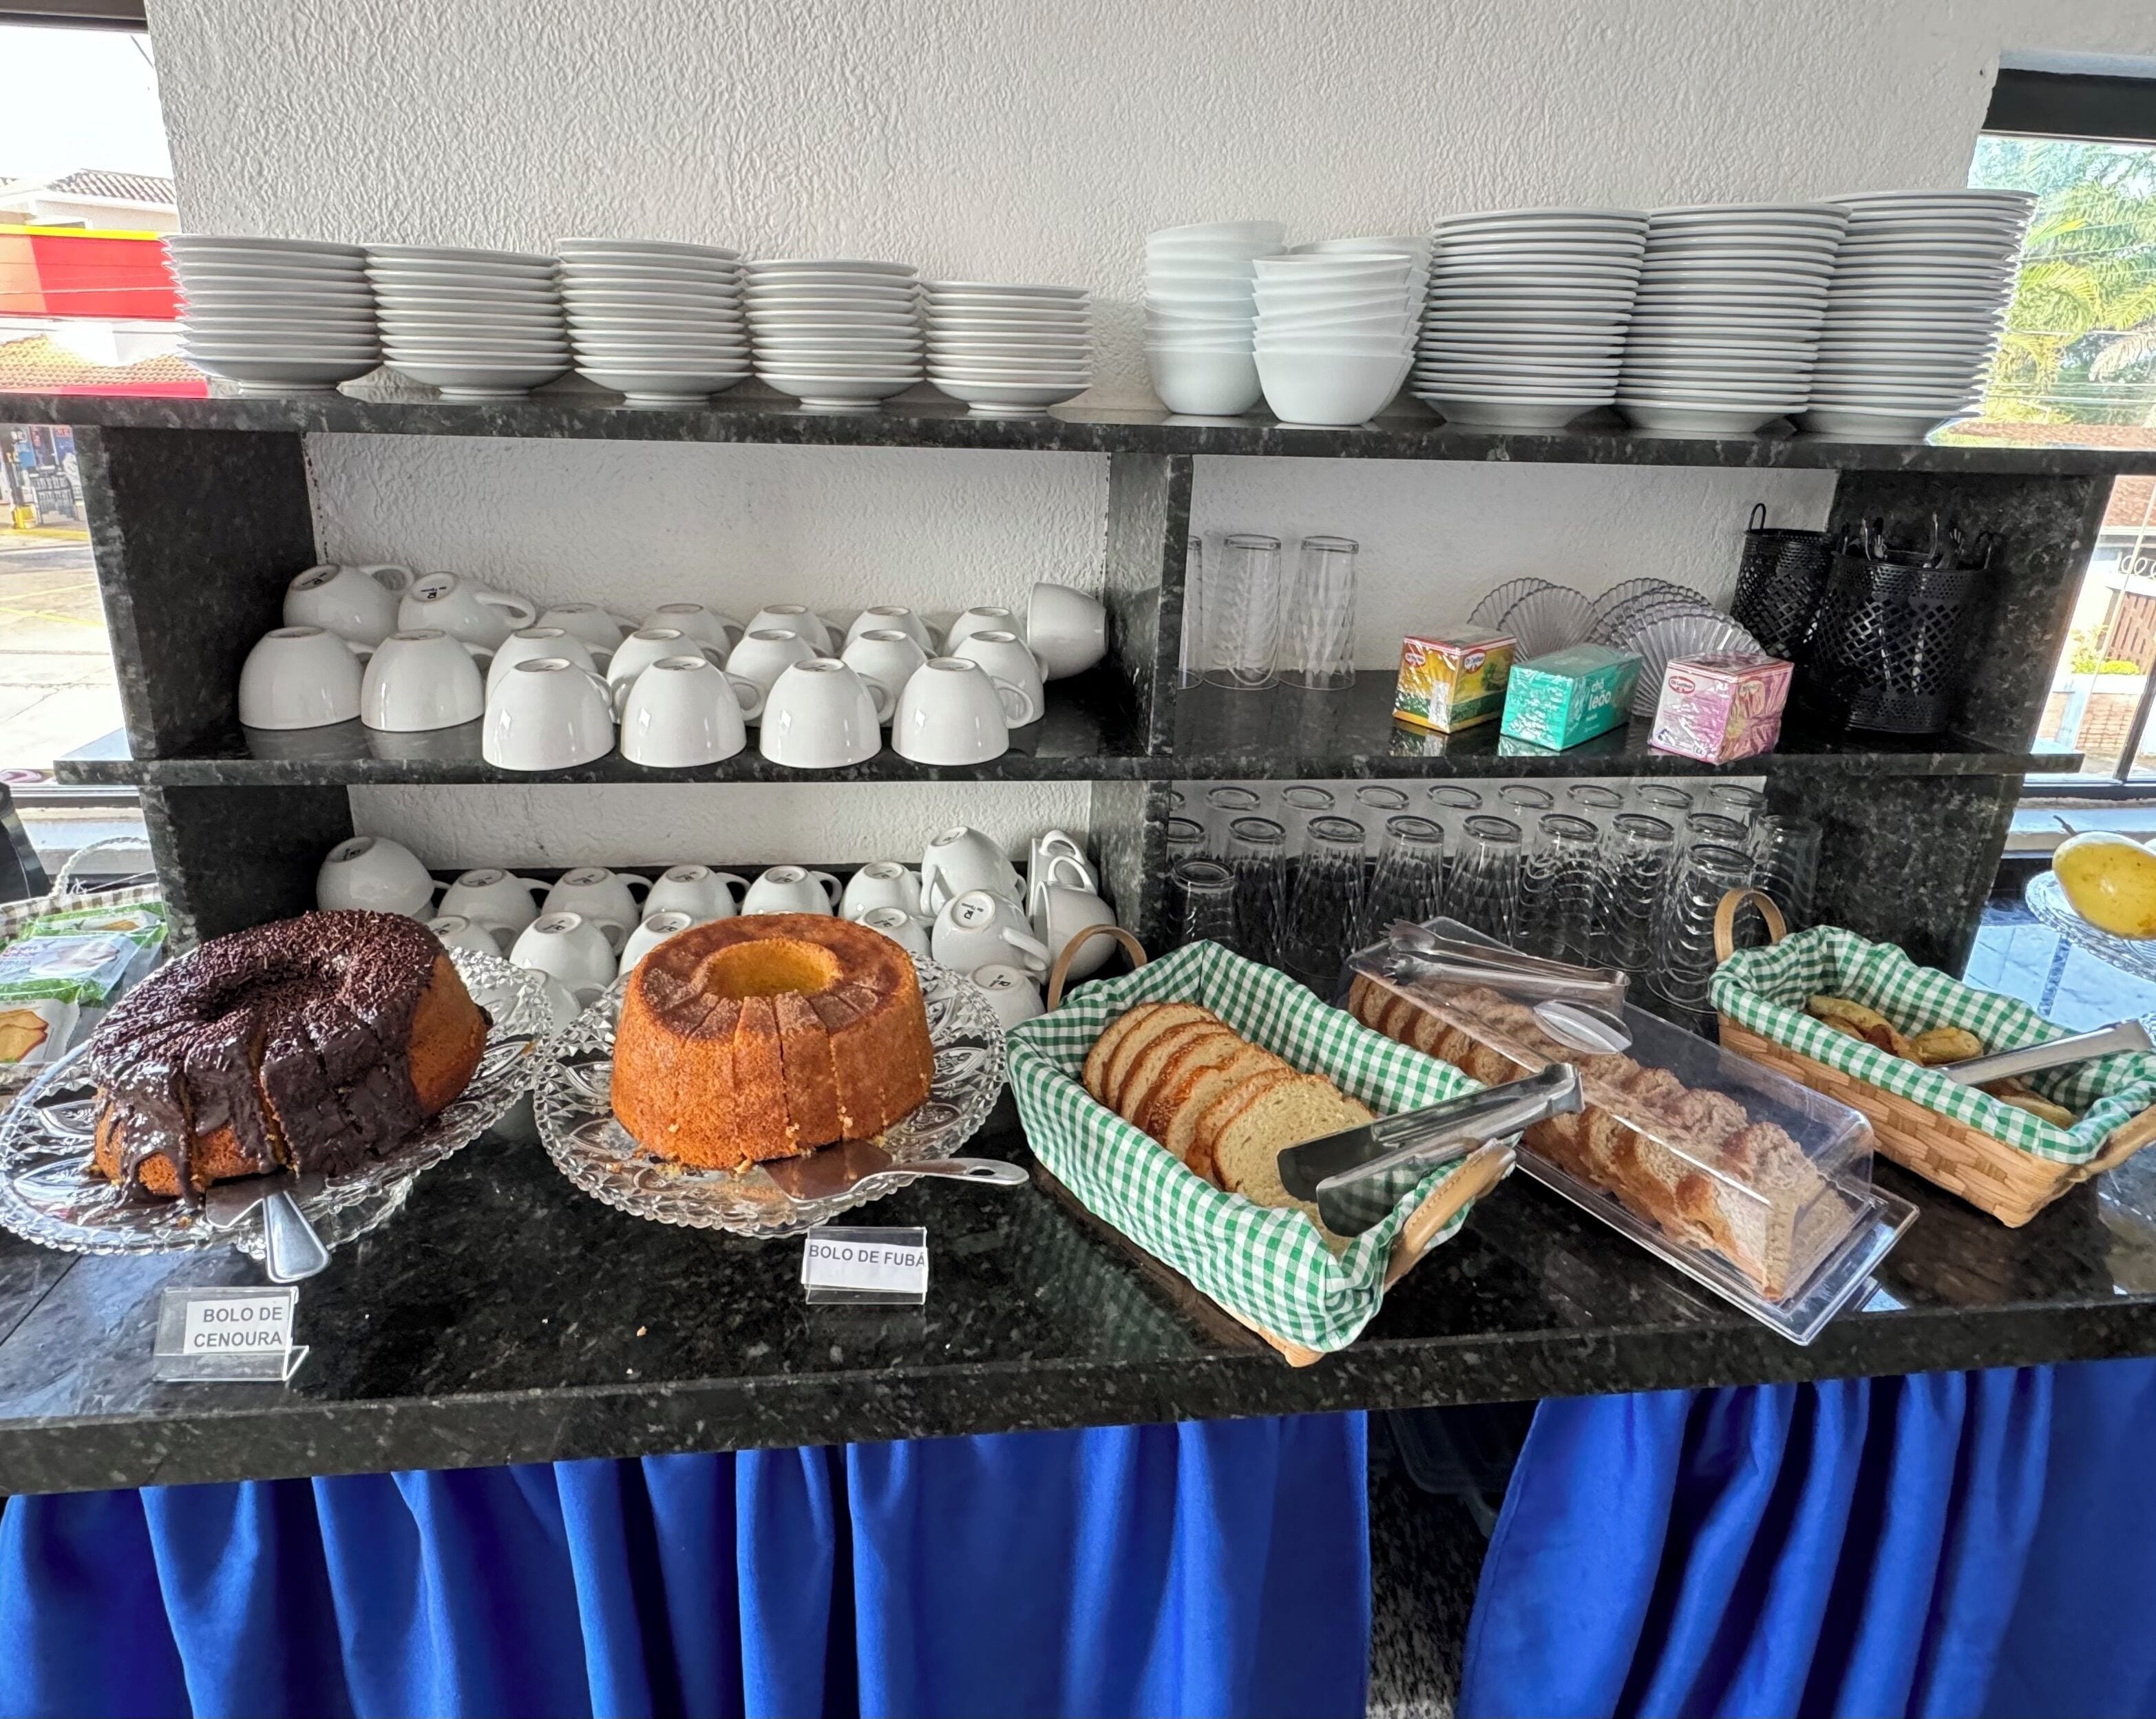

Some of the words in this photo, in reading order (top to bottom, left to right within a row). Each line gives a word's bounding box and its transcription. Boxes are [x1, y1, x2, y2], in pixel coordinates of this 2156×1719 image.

[1588, 689, 1611, 710] leão
[809, 1245, 853, 1261] BOLO
[858, 1249, 879, 1263] DE
[884, 1252, 926, 1267] FUBÁ
[204, 1307, 254, 1322] BOLO
[260, 1307, 283, 1321] DE
[194, 1331, 283, 1347] CENOURA
